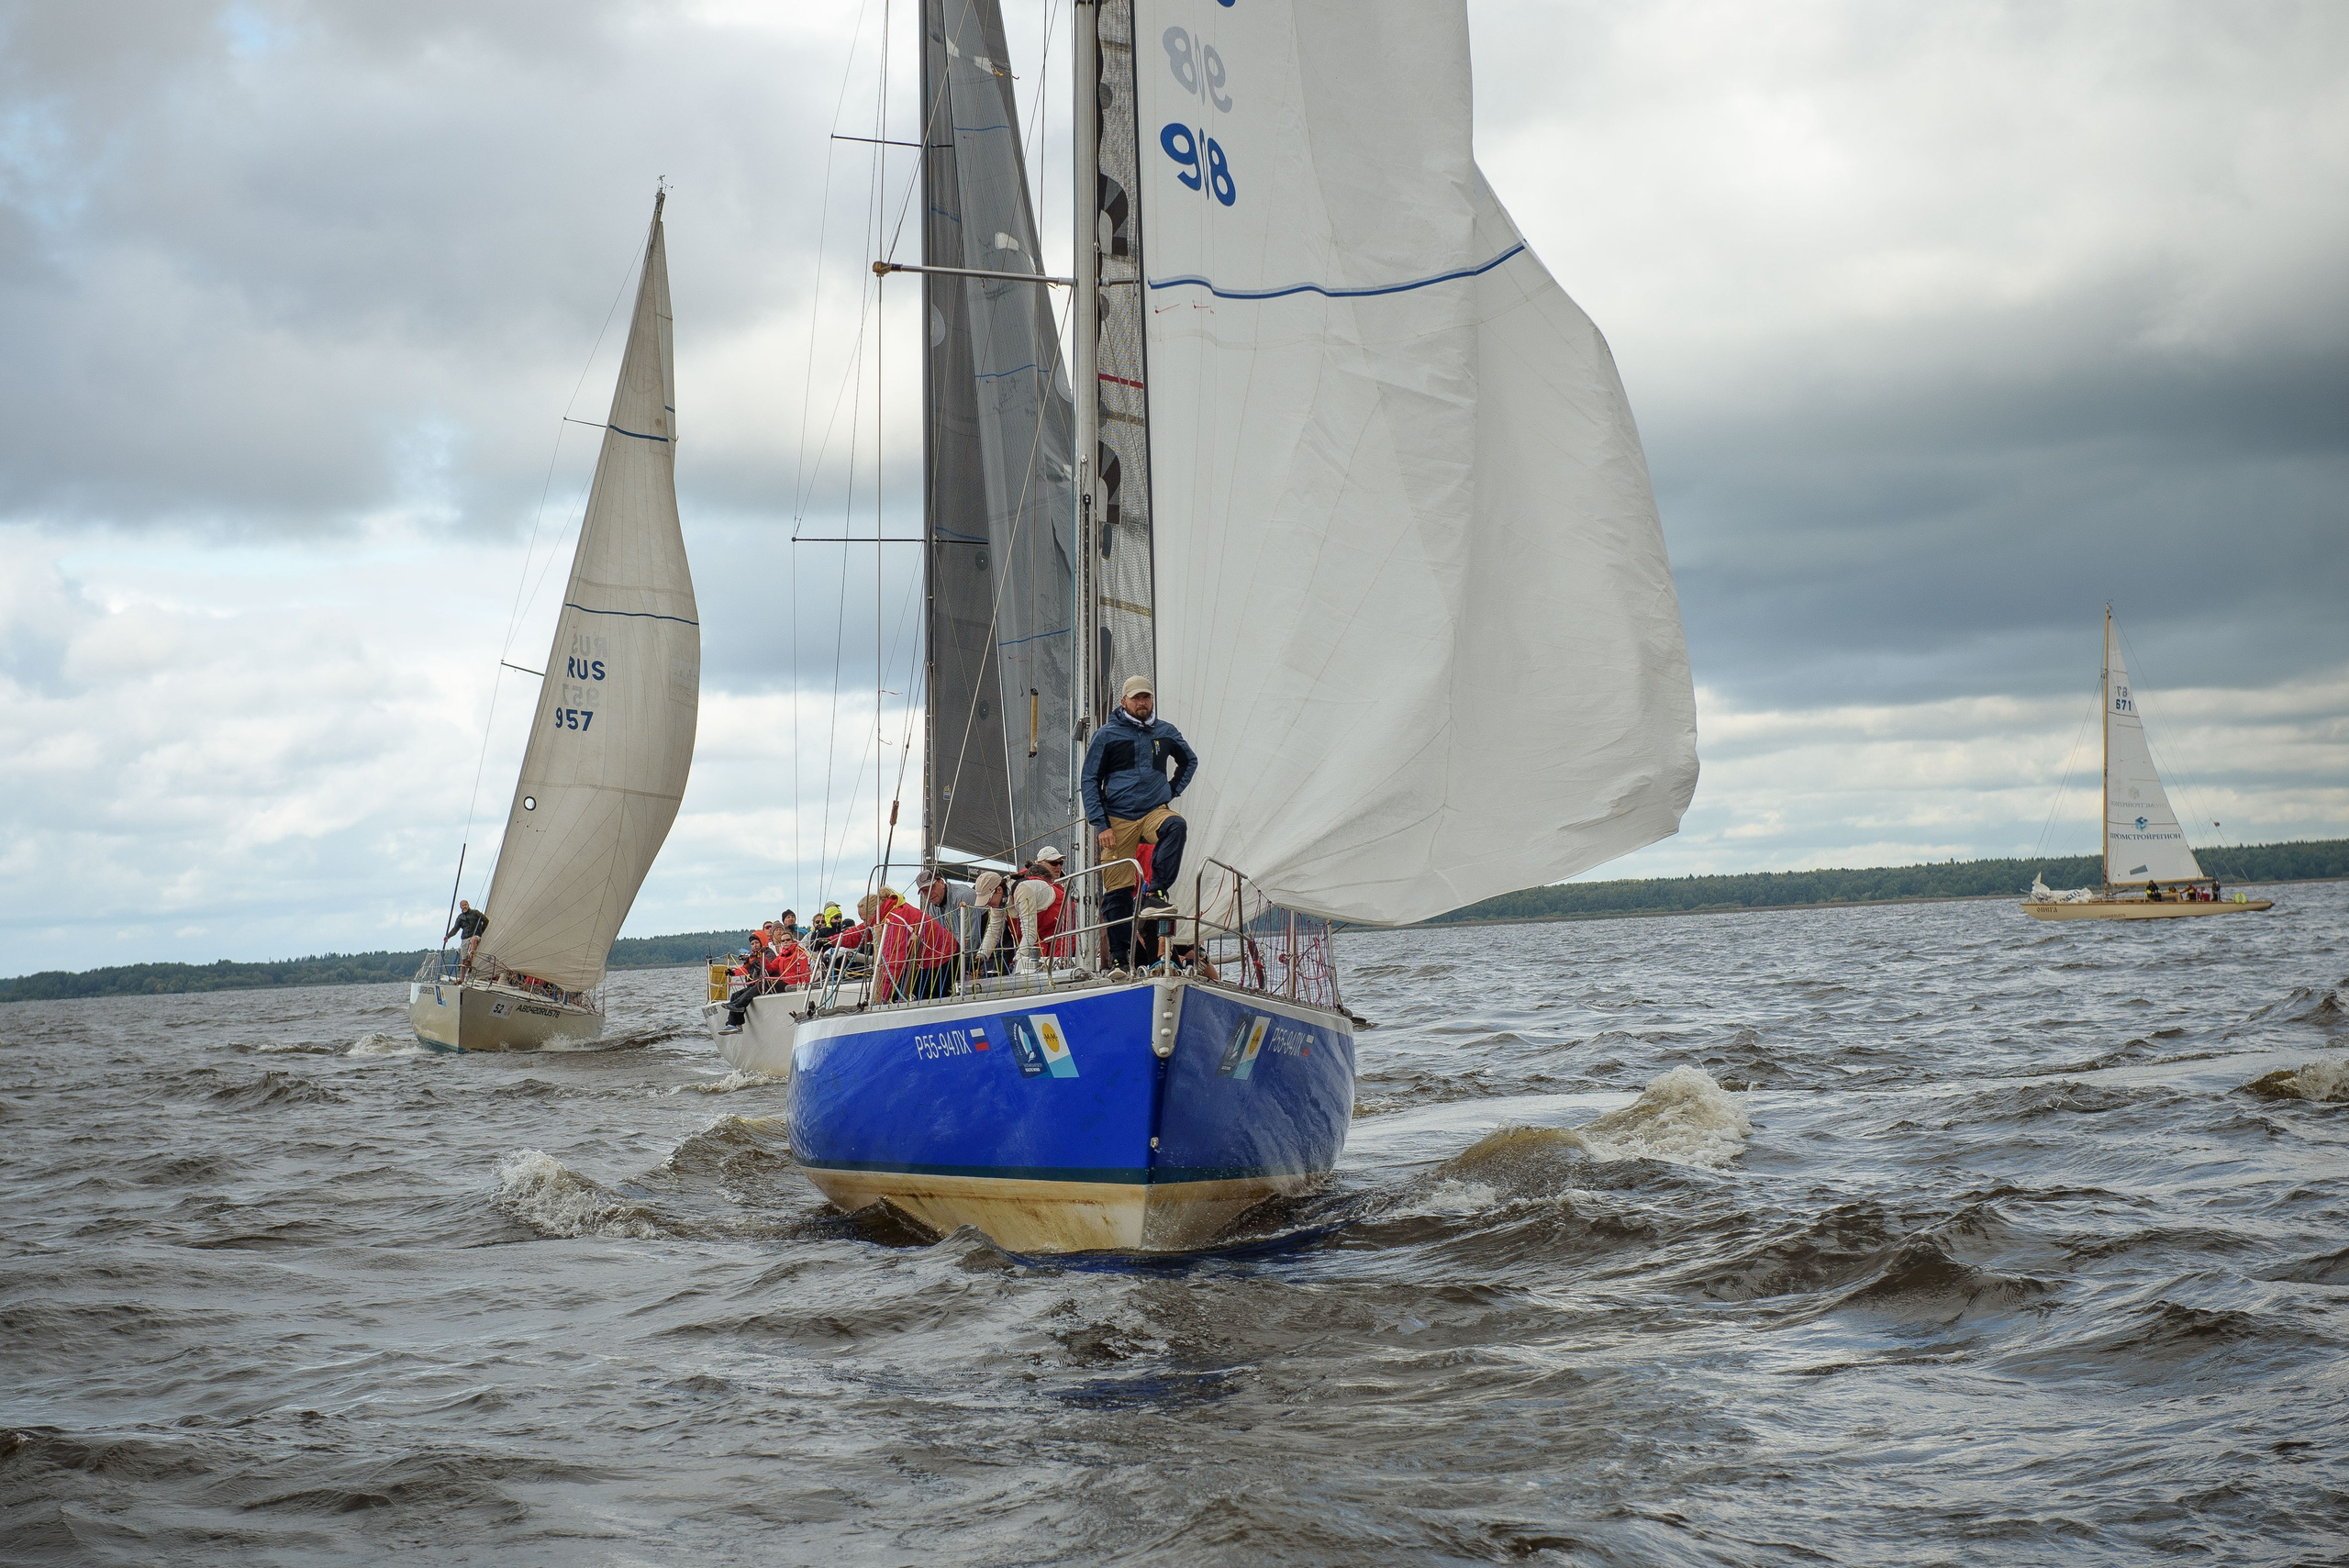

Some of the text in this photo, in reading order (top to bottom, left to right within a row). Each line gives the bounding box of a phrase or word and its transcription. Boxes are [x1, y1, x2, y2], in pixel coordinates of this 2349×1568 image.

[568, 655, 606, 681] RUS
[2116, 698, 2132, 711] 671
[555, 706, 594, 731] 957
[493, 1004, 505, 1014] 52
